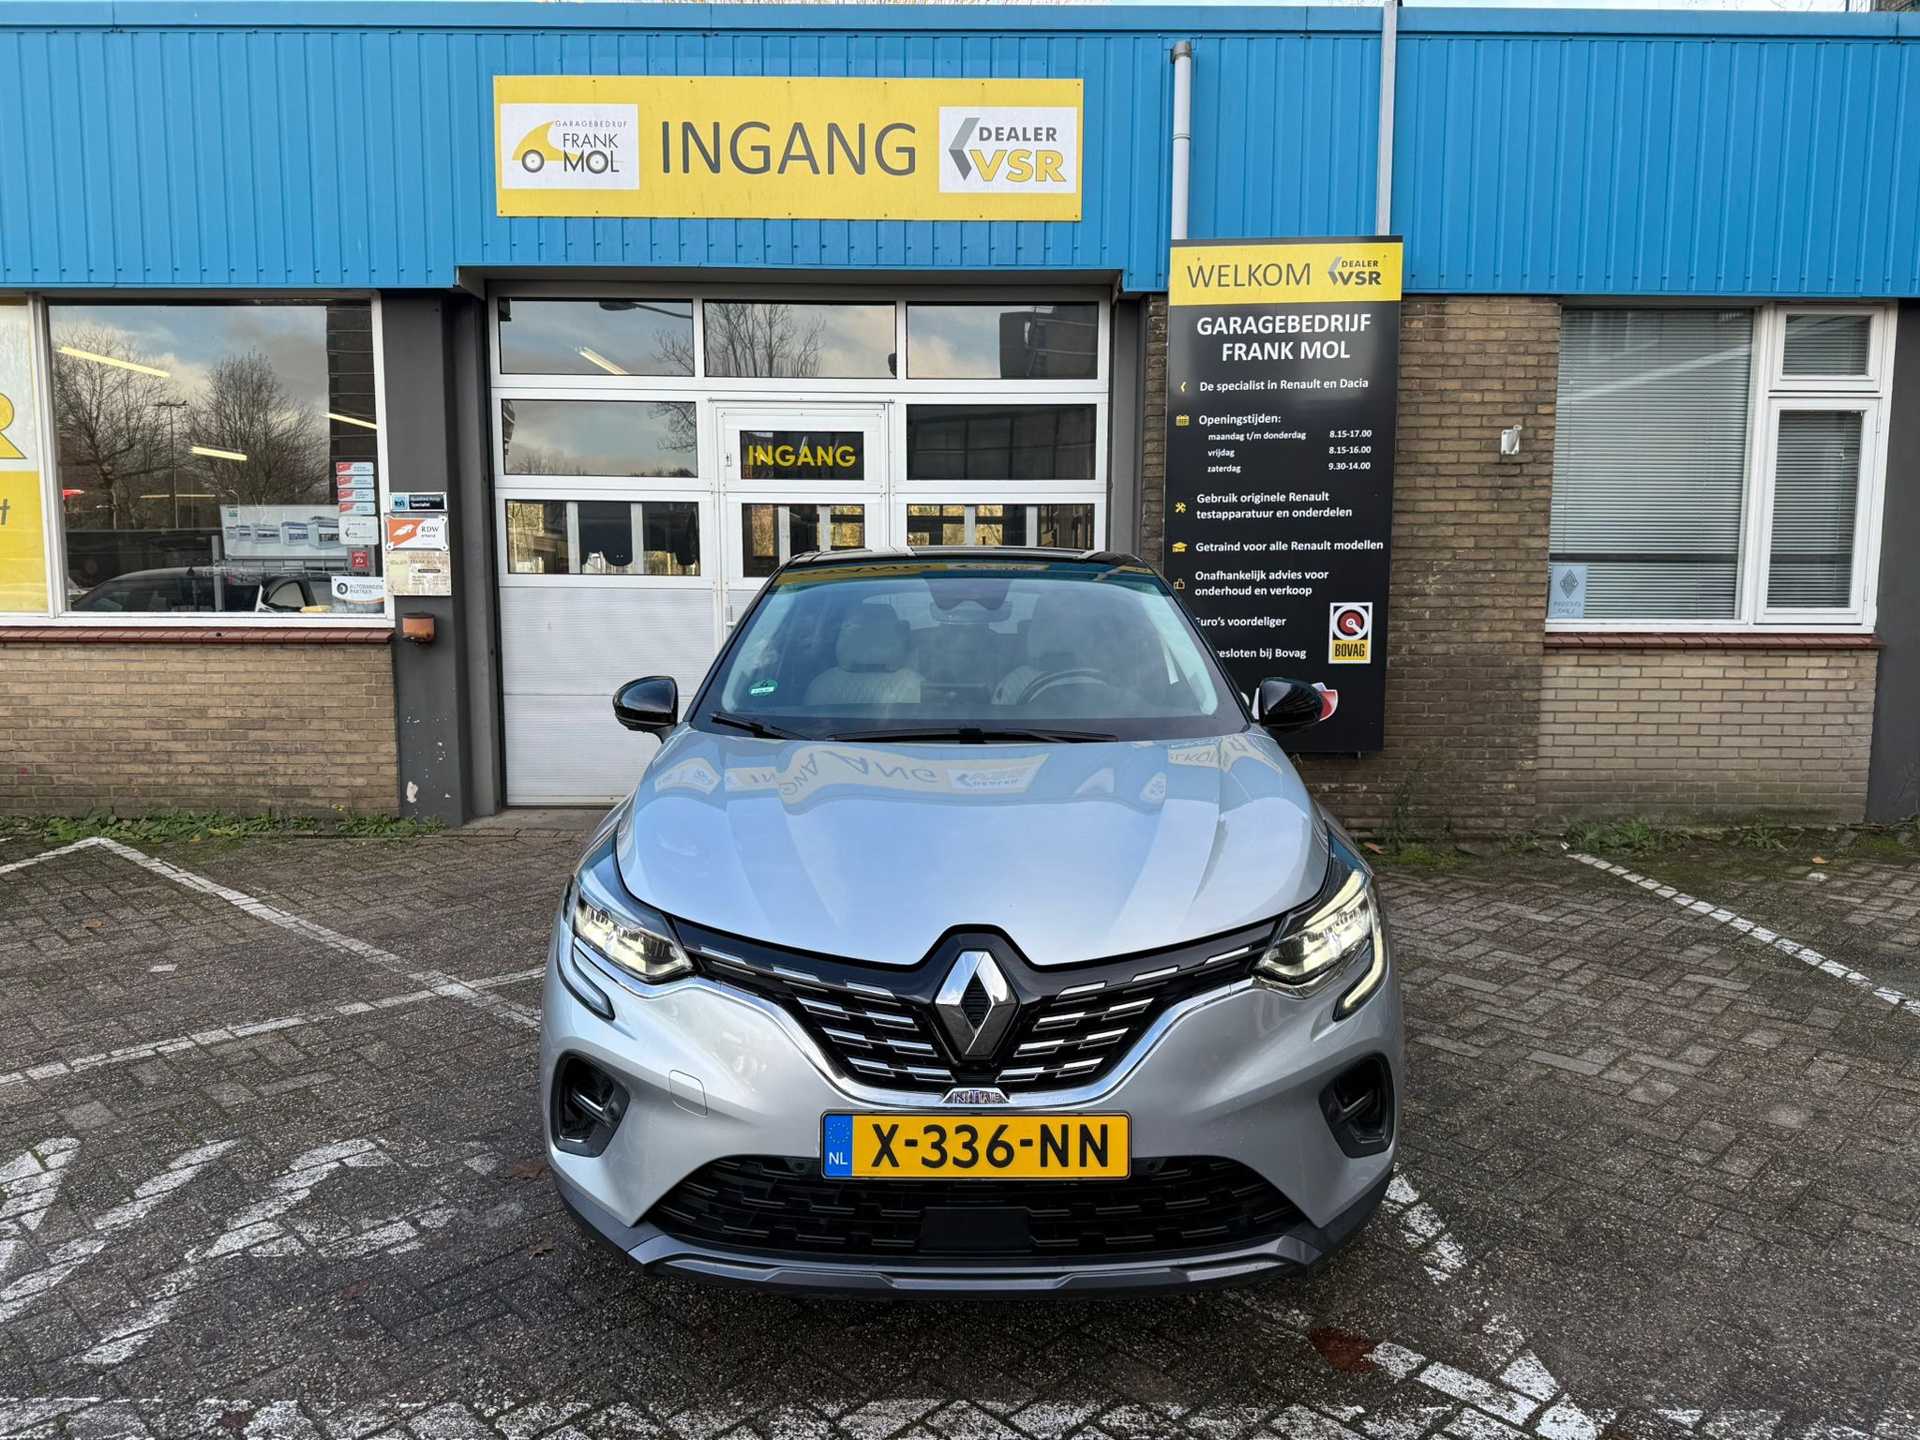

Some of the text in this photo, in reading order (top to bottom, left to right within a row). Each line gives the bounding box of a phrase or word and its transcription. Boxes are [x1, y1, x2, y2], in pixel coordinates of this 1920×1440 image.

[555, 120, 627, 128] GARAGEBEDRIJF
[562, 133, 618, 148] FRANK
[979, 127, 1057, 142] DEALER
[661, 120, 917, 176] INGANG
[563, 149, 620, 174] MOL
[969, 149, 1067, 183] VSR
[1341, 259, 1379, 269] DEALER
[1187, 262, 1311, 288] WELKOM
[1338, 271, 1382, 286] VSR
[1196, 313, 1371, 336] GARAGEBEDRIJF
[1222, 340, 1350, 361] FRANK MOL
[1199, 378, 1369, 393] De specialist in Renault en Dacia
[1198, 414, 1281, 427] Openingstijden:
[1207, 429, 1372, 442] maandag t/m donderdag 8.15-17.00
[748, 445, 856, 467] INGANG
[1207, 445, 1372, 458] vrijdag 8.15-16.00
[1207, 461, 1371, 474] zaterdag 9.30-14.00
[1196, 491, 1329, 505] Gebruik originele Renault
[1196, 507, 1352, 520] testapparatuur en onderdelen
[421, 525, 440, 533] RDW
[1195, 539, 1383, 552] Getraind voor alle Renault modellen
[1195, 570, 1329, 582] Onafhankelijk advies voor
[1195, 585, 1312, 597] onderhoud en verkoop
[1227, 616, 1287, 628] voordeliger
[1217, 647, 1307, 660] esloten bij Bovag
[1334, 643, 1365, 658] BOVAG
[870, 1123, 1109, 1169] X-336-NN
[828, 1151, 849, 1165] NL
